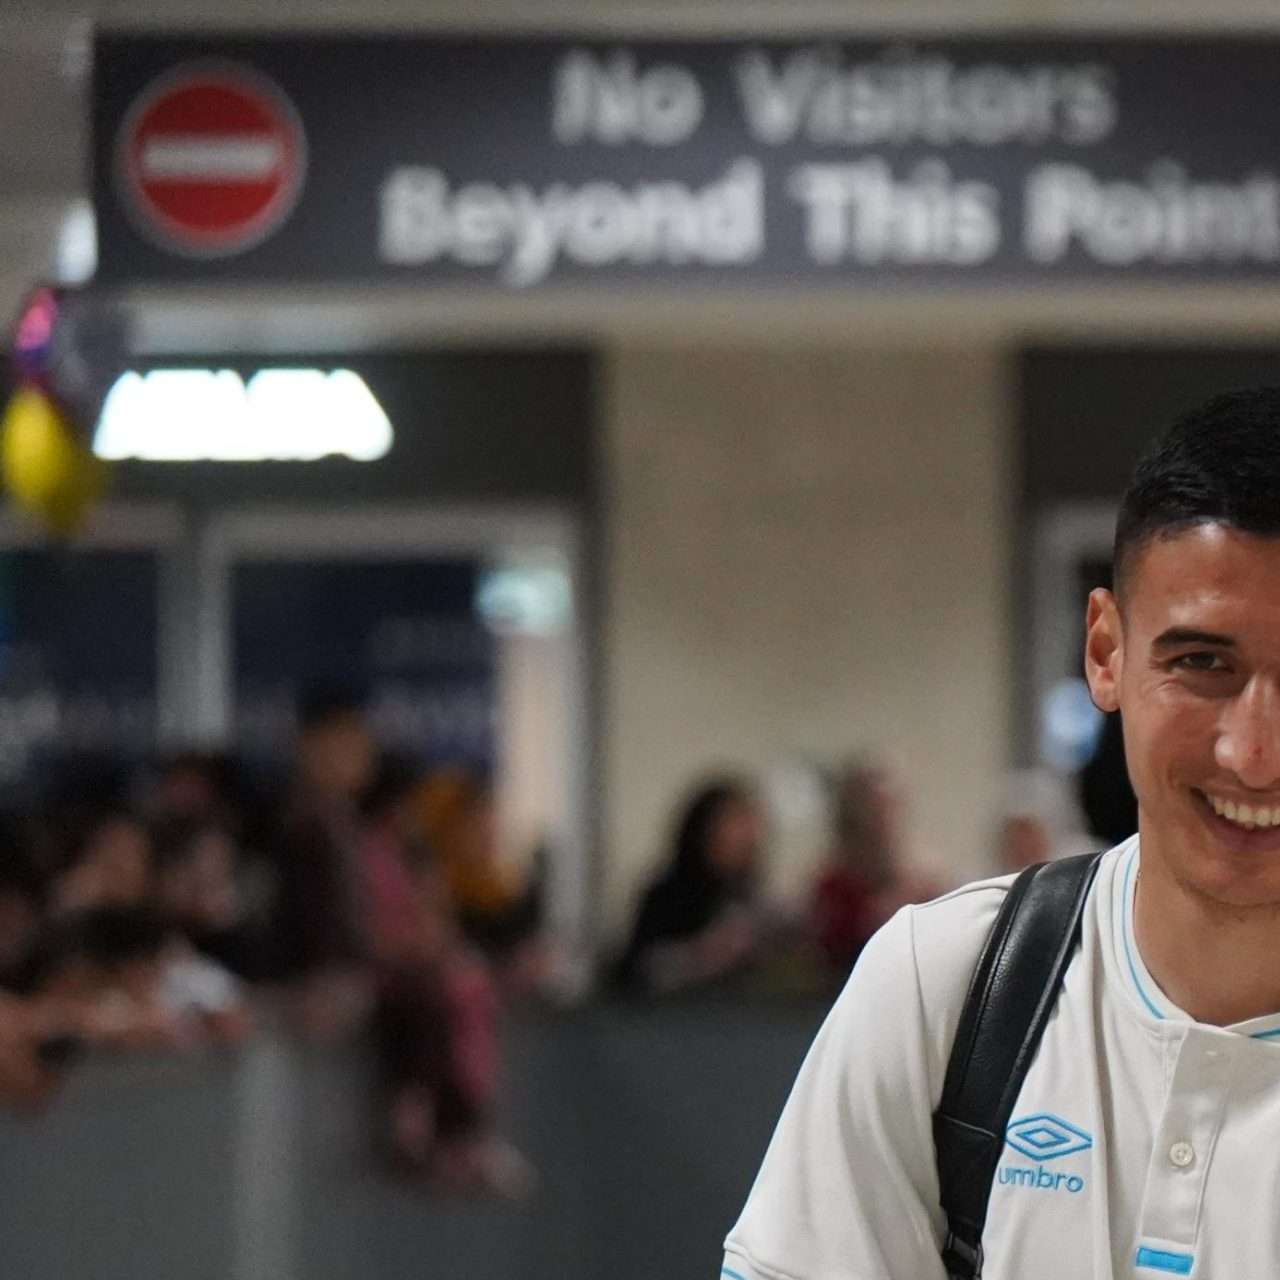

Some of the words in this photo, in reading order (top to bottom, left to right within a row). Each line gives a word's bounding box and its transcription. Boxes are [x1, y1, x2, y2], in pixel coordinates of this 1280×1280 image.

[555, 53, 701, 145] No
[733, 51, 1116, 145] Visitors
[380, 159, 761, 285] Beyond
[790, 159, 998, 263] This
[998, 1165, 1084, 1193] umbro
